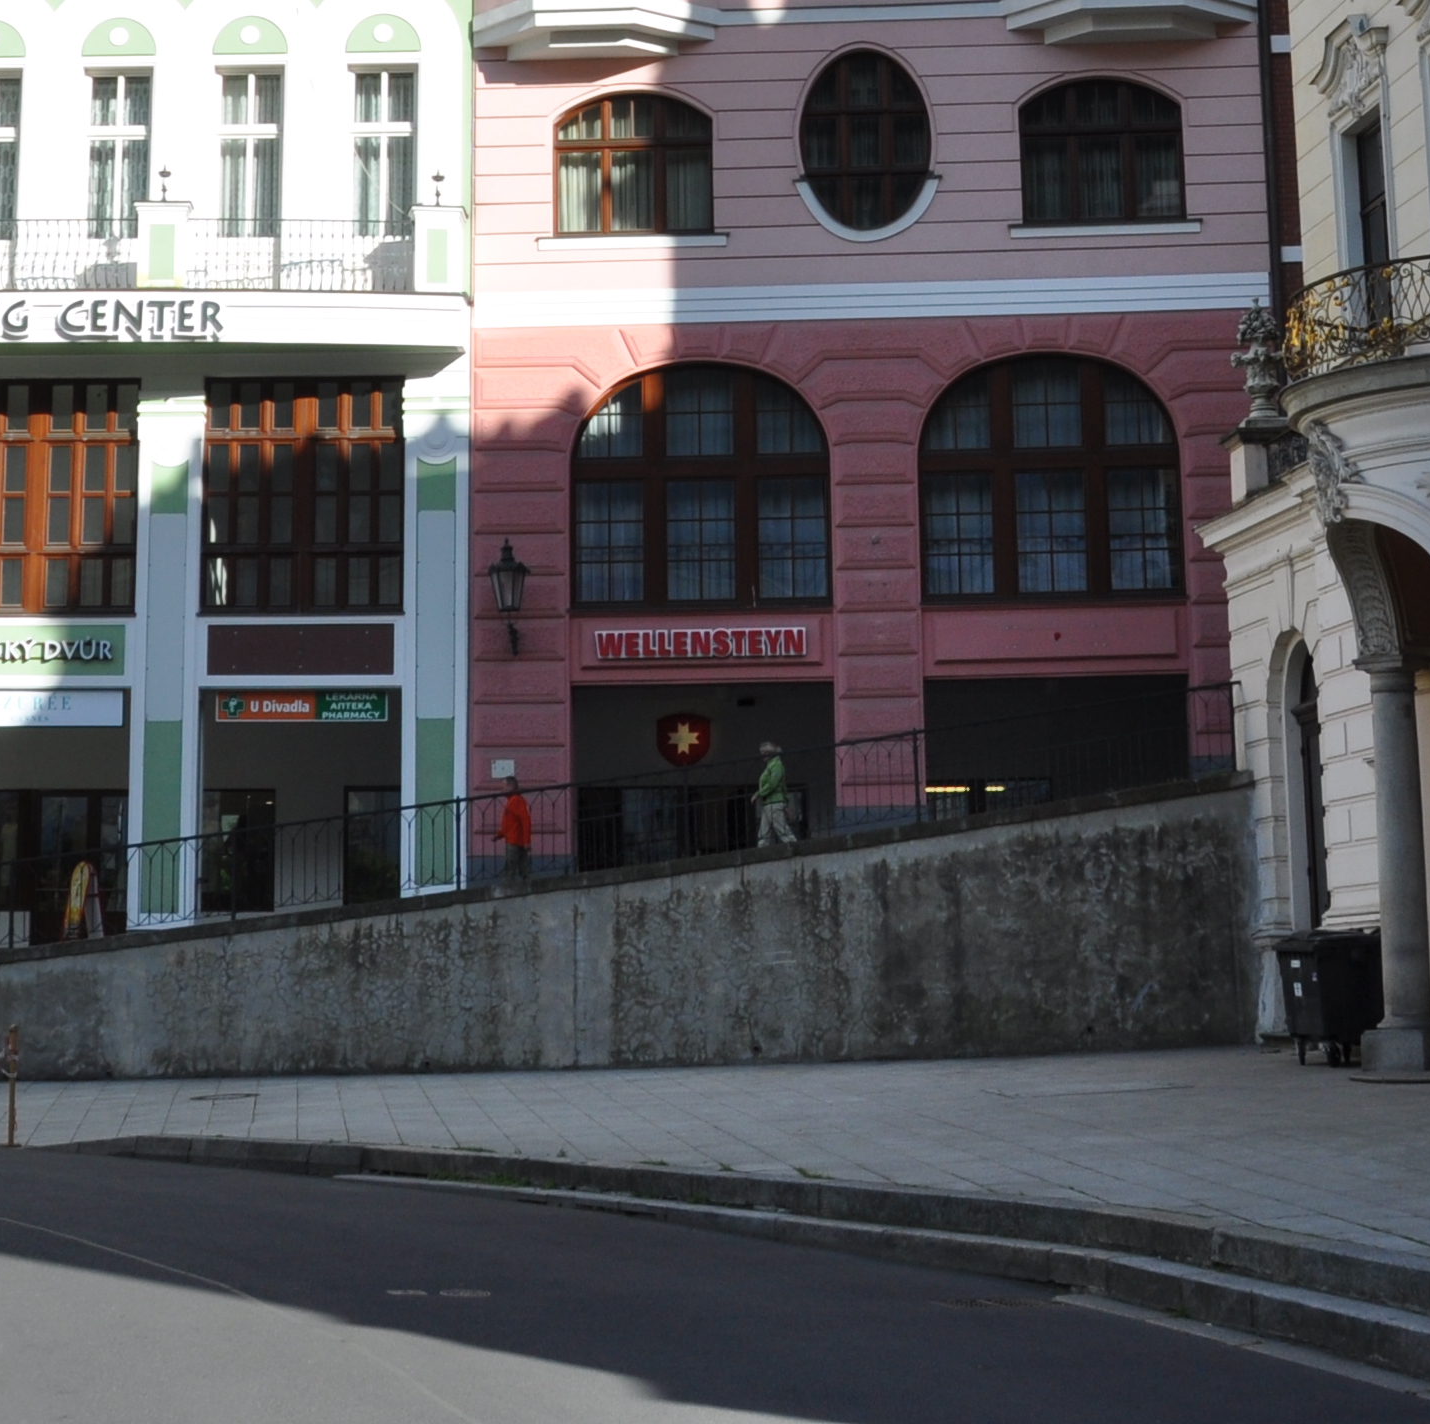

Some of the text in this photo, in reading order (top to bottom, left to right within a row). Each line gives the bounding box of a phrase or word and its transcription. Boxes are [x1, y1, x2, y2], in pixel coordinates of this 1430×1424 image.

[59, 299, 224, 336] CENTER
[594, 627, 807, 660] WELLENSTEYN
[250, 700, 310, 713] U Divadla
[330, 702, 373, 711] АПТЕКА
[322, 711, 380, 719] PHARMACY
